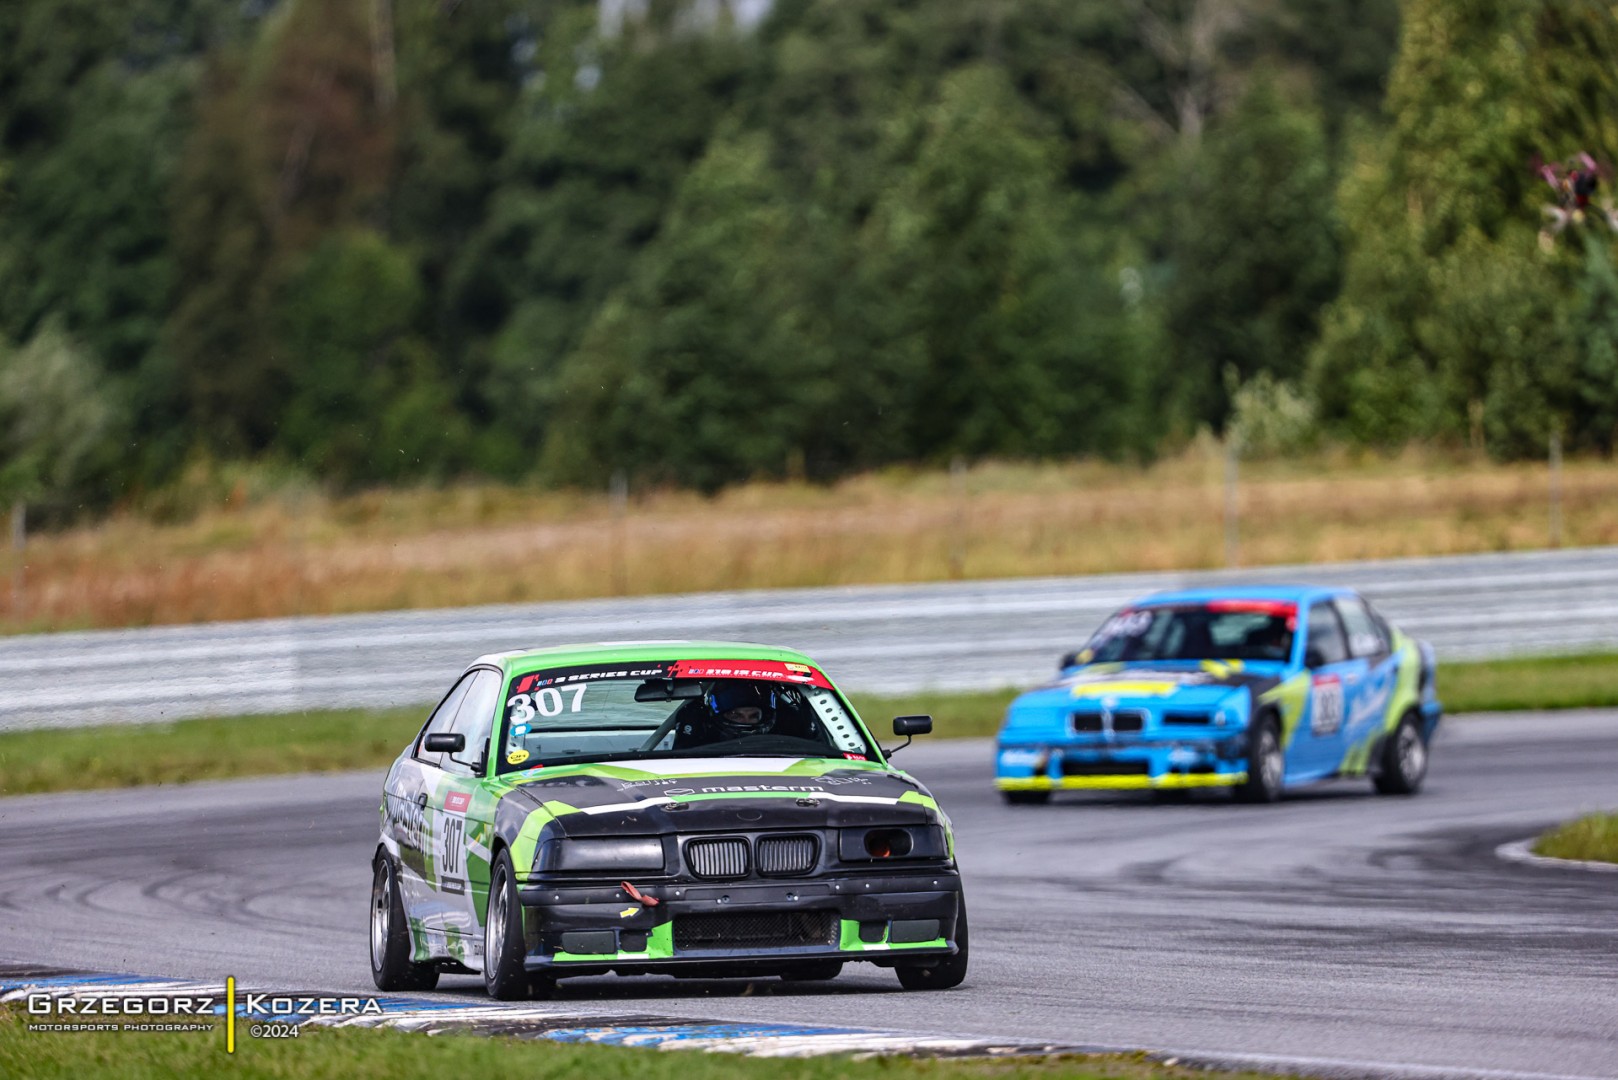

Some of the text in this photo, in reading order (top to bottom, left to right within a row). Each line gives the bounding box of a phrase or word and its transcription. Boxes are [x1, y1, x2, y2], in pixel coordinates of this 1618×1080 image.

[568, 670, 628, 681] SERIES
[751, 670, 784, 679] CUP
[507, 683, 587, 725] 307
[701, 783, 824, 793] masterm
[442, 817, 463, 874] 307
